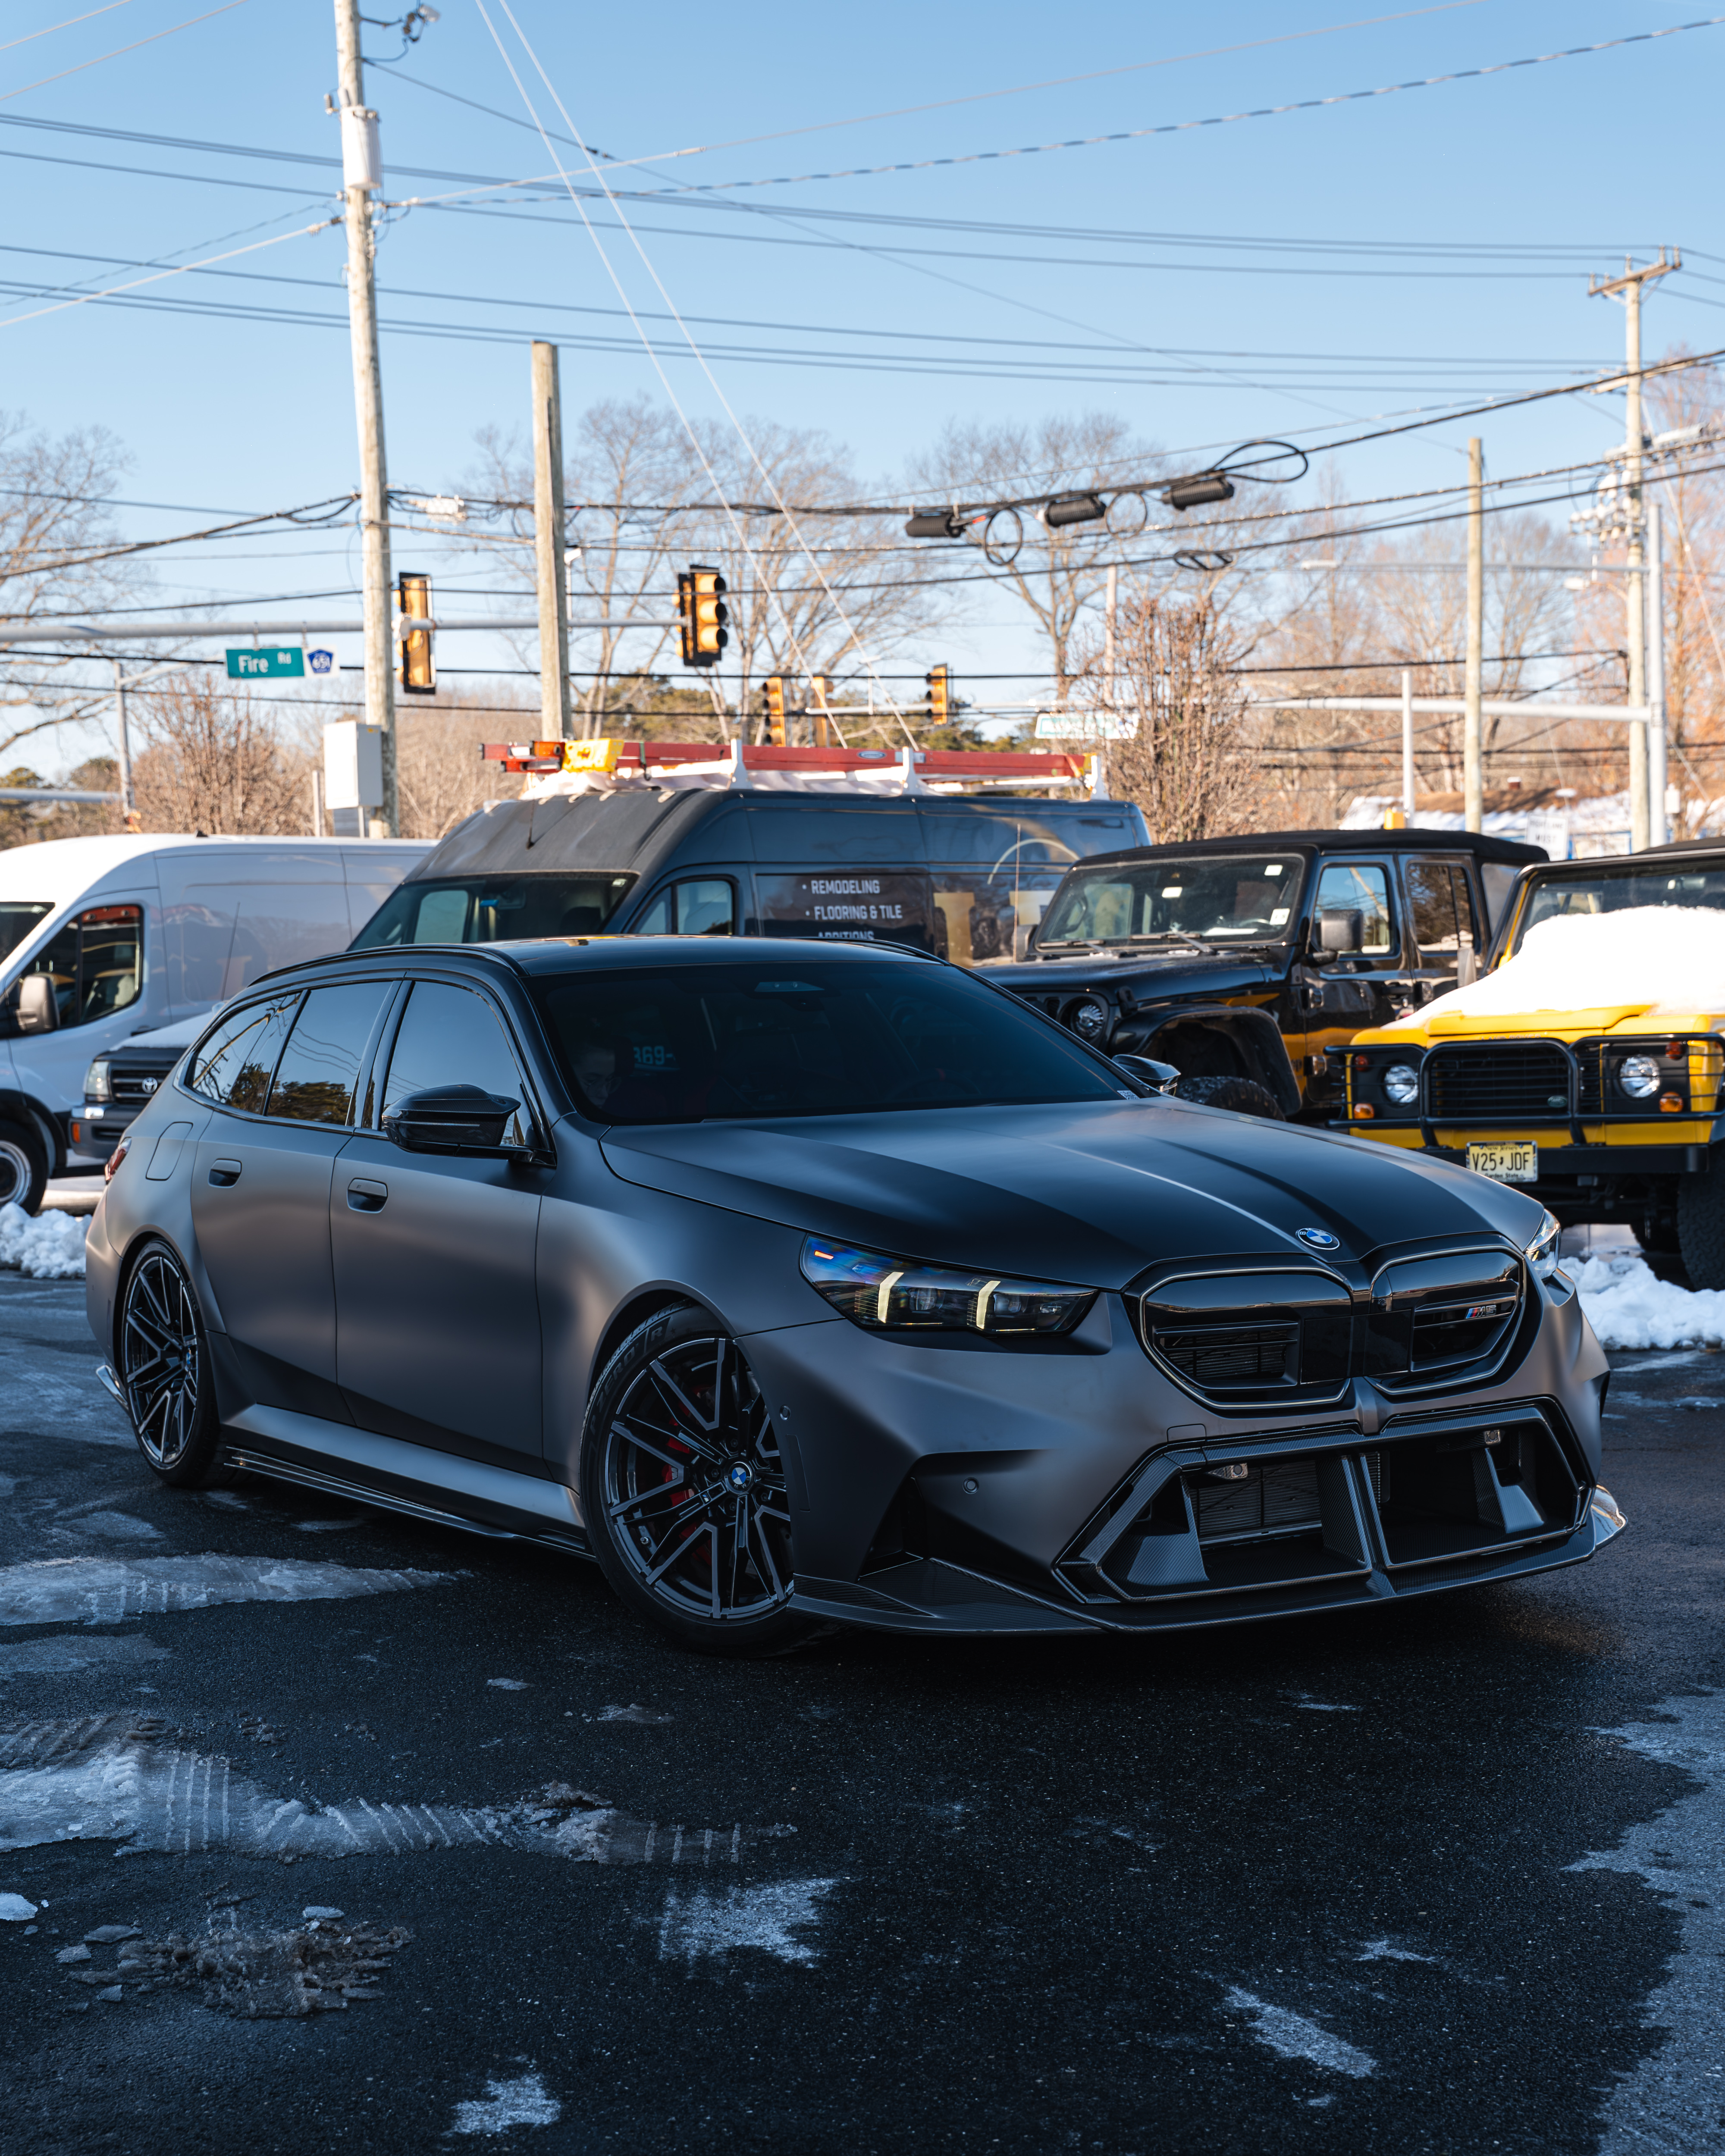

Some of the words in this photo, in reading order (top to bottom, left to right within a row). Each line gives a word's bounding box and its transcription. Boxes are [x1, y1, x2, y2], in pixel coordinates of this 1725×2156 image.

[238, 655, 269, 673] Fire
[277, 652, 292, 664] Rd
[312, 654, 330, 669] 651
[811, 880, 880, 894] REMODELING
[814, 905, 868, 920] FLOORING
[869, 905, 878, 919] &
[879, 904, 903, 919] TILE
[1472, 1153, 1496, 1171] V25
[1507, 1152, 1530, 1171] JDF
[651, 1326, 663, 1342] R
[590, 1415, 596, 1435] P
